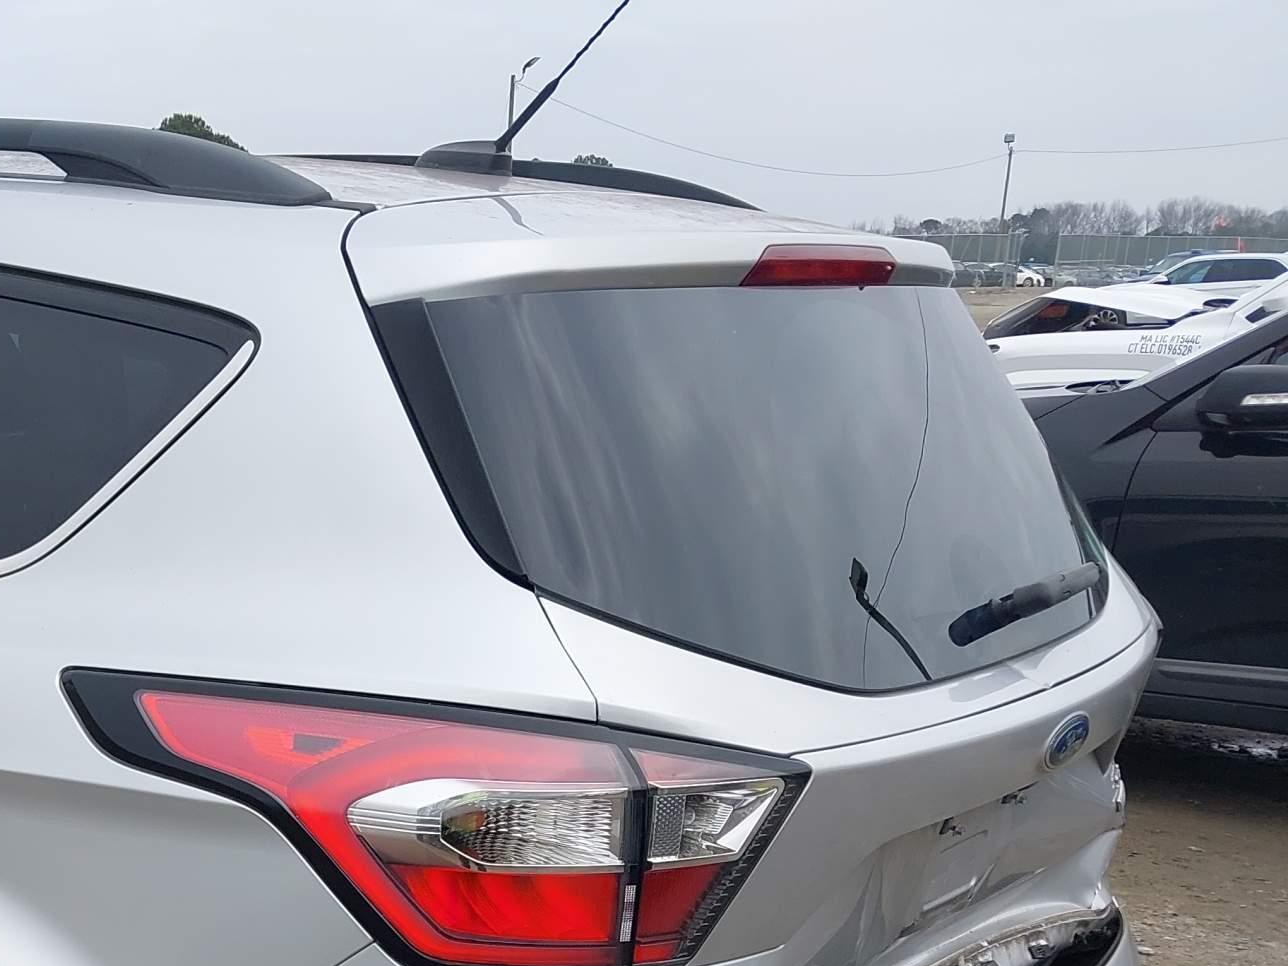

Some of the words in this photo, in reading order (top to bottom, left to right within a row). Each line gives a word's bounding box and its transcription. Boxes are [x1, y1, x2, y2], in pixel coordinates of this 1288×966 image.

[1140, 334, 1153, 343] MA
[1154, 334, 1169, 343] LIC
[1127, 343, 1139, 354] CT
[1139, 343, 1156, 354] ELC
